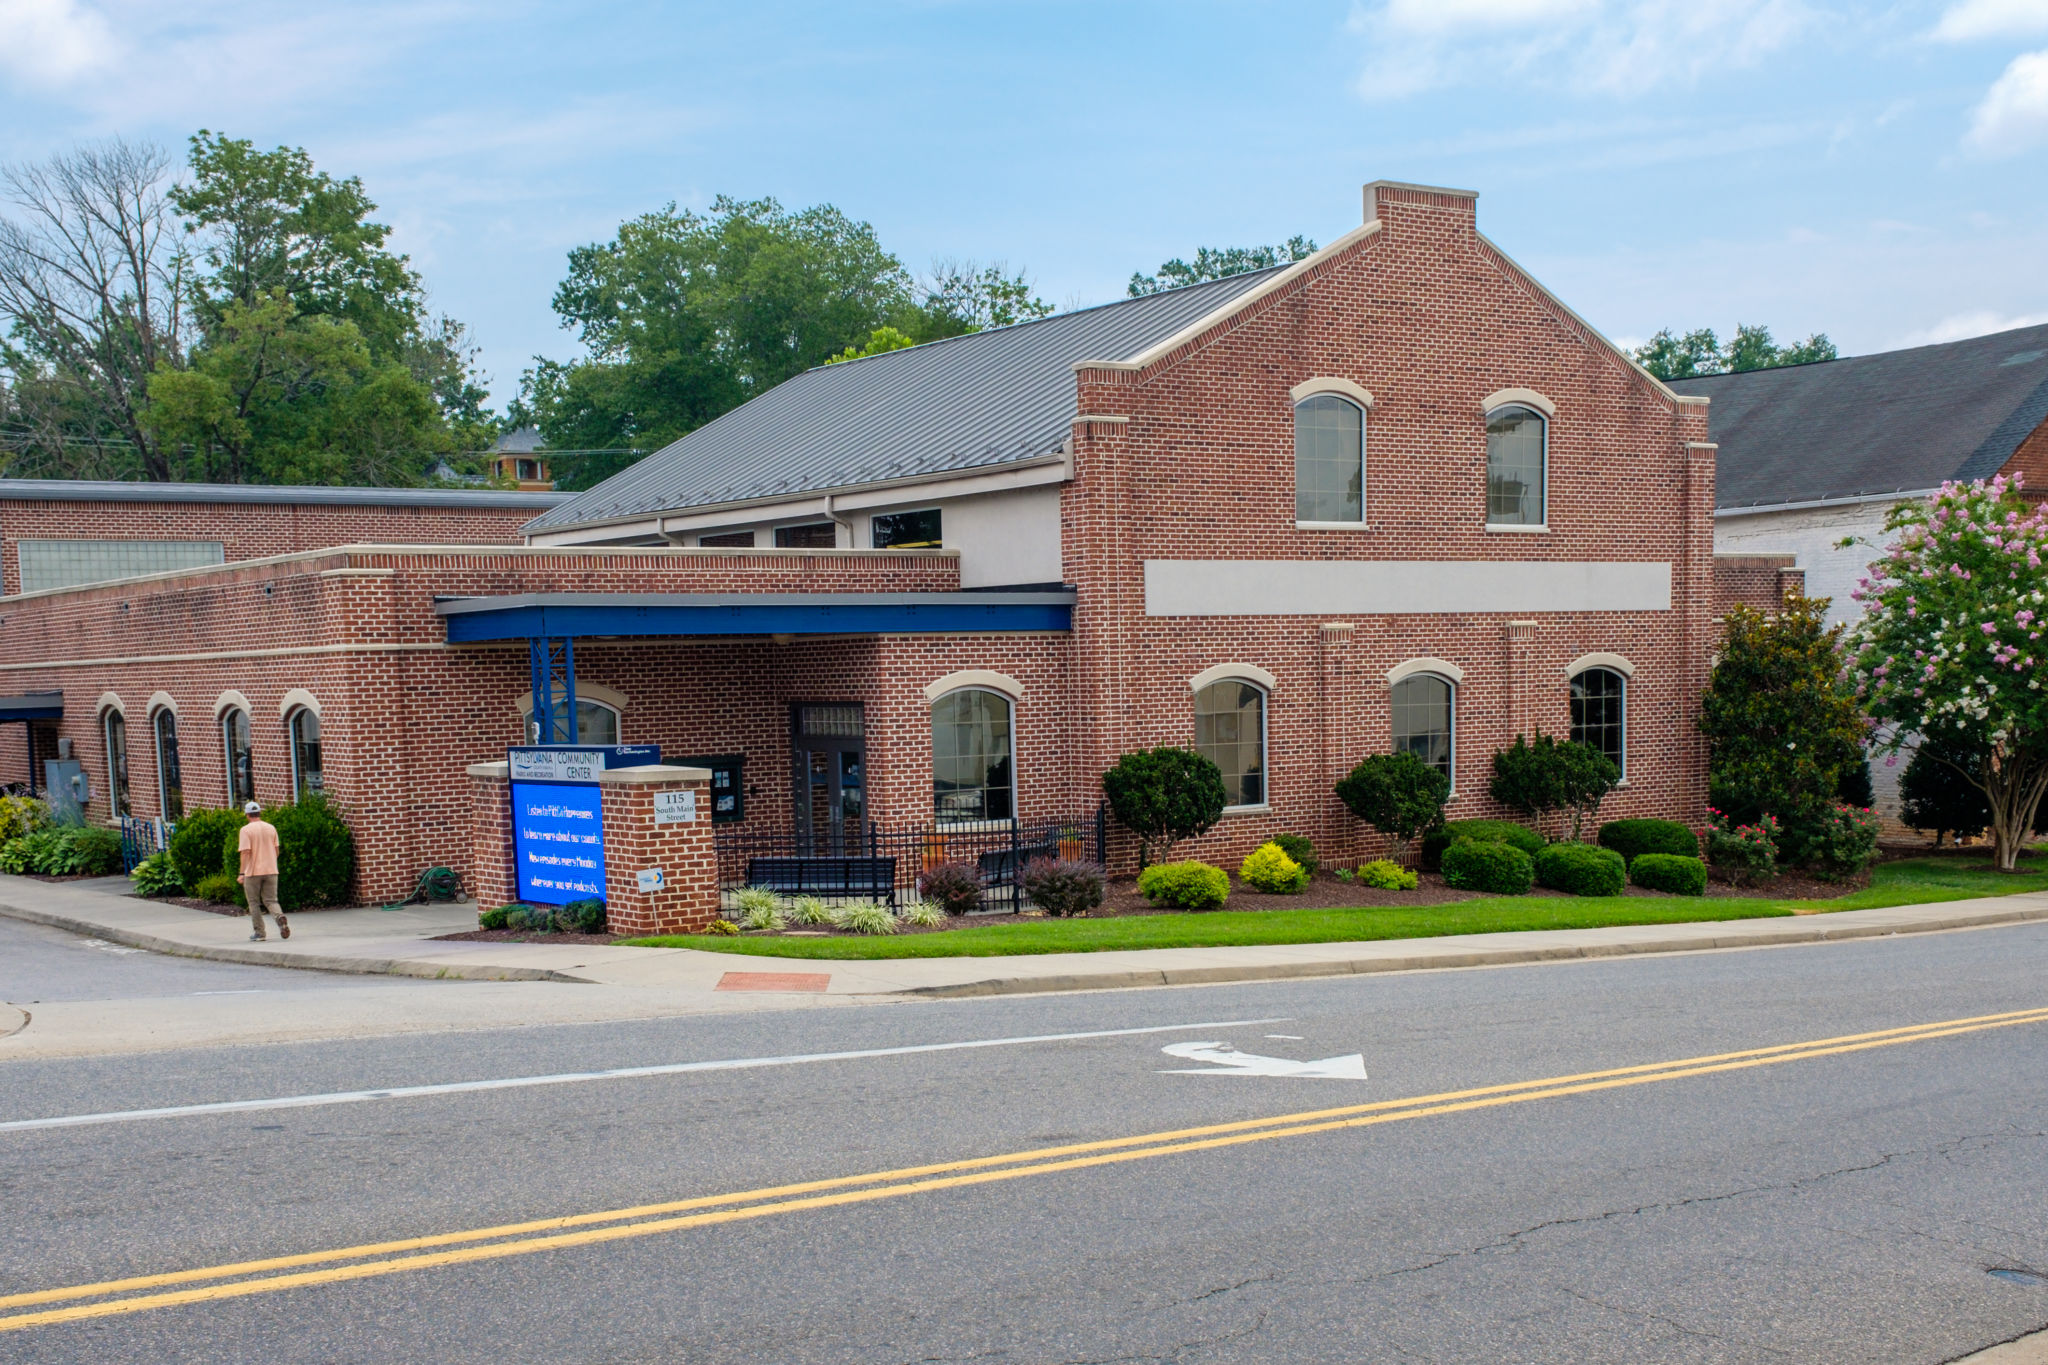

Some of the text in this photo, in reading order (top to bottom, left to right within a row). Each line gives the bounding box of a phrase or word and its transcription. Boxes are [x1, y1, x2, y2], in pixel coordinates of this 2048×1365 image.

[515, 751, 553, 763] PITTSYLVANIA
[557, 752, 600, 764] COMMUNITY
[567, 766, 591, 779] CENTER
[667, 794, 685, 804] 115
[677, 805, 694, 813] Main
